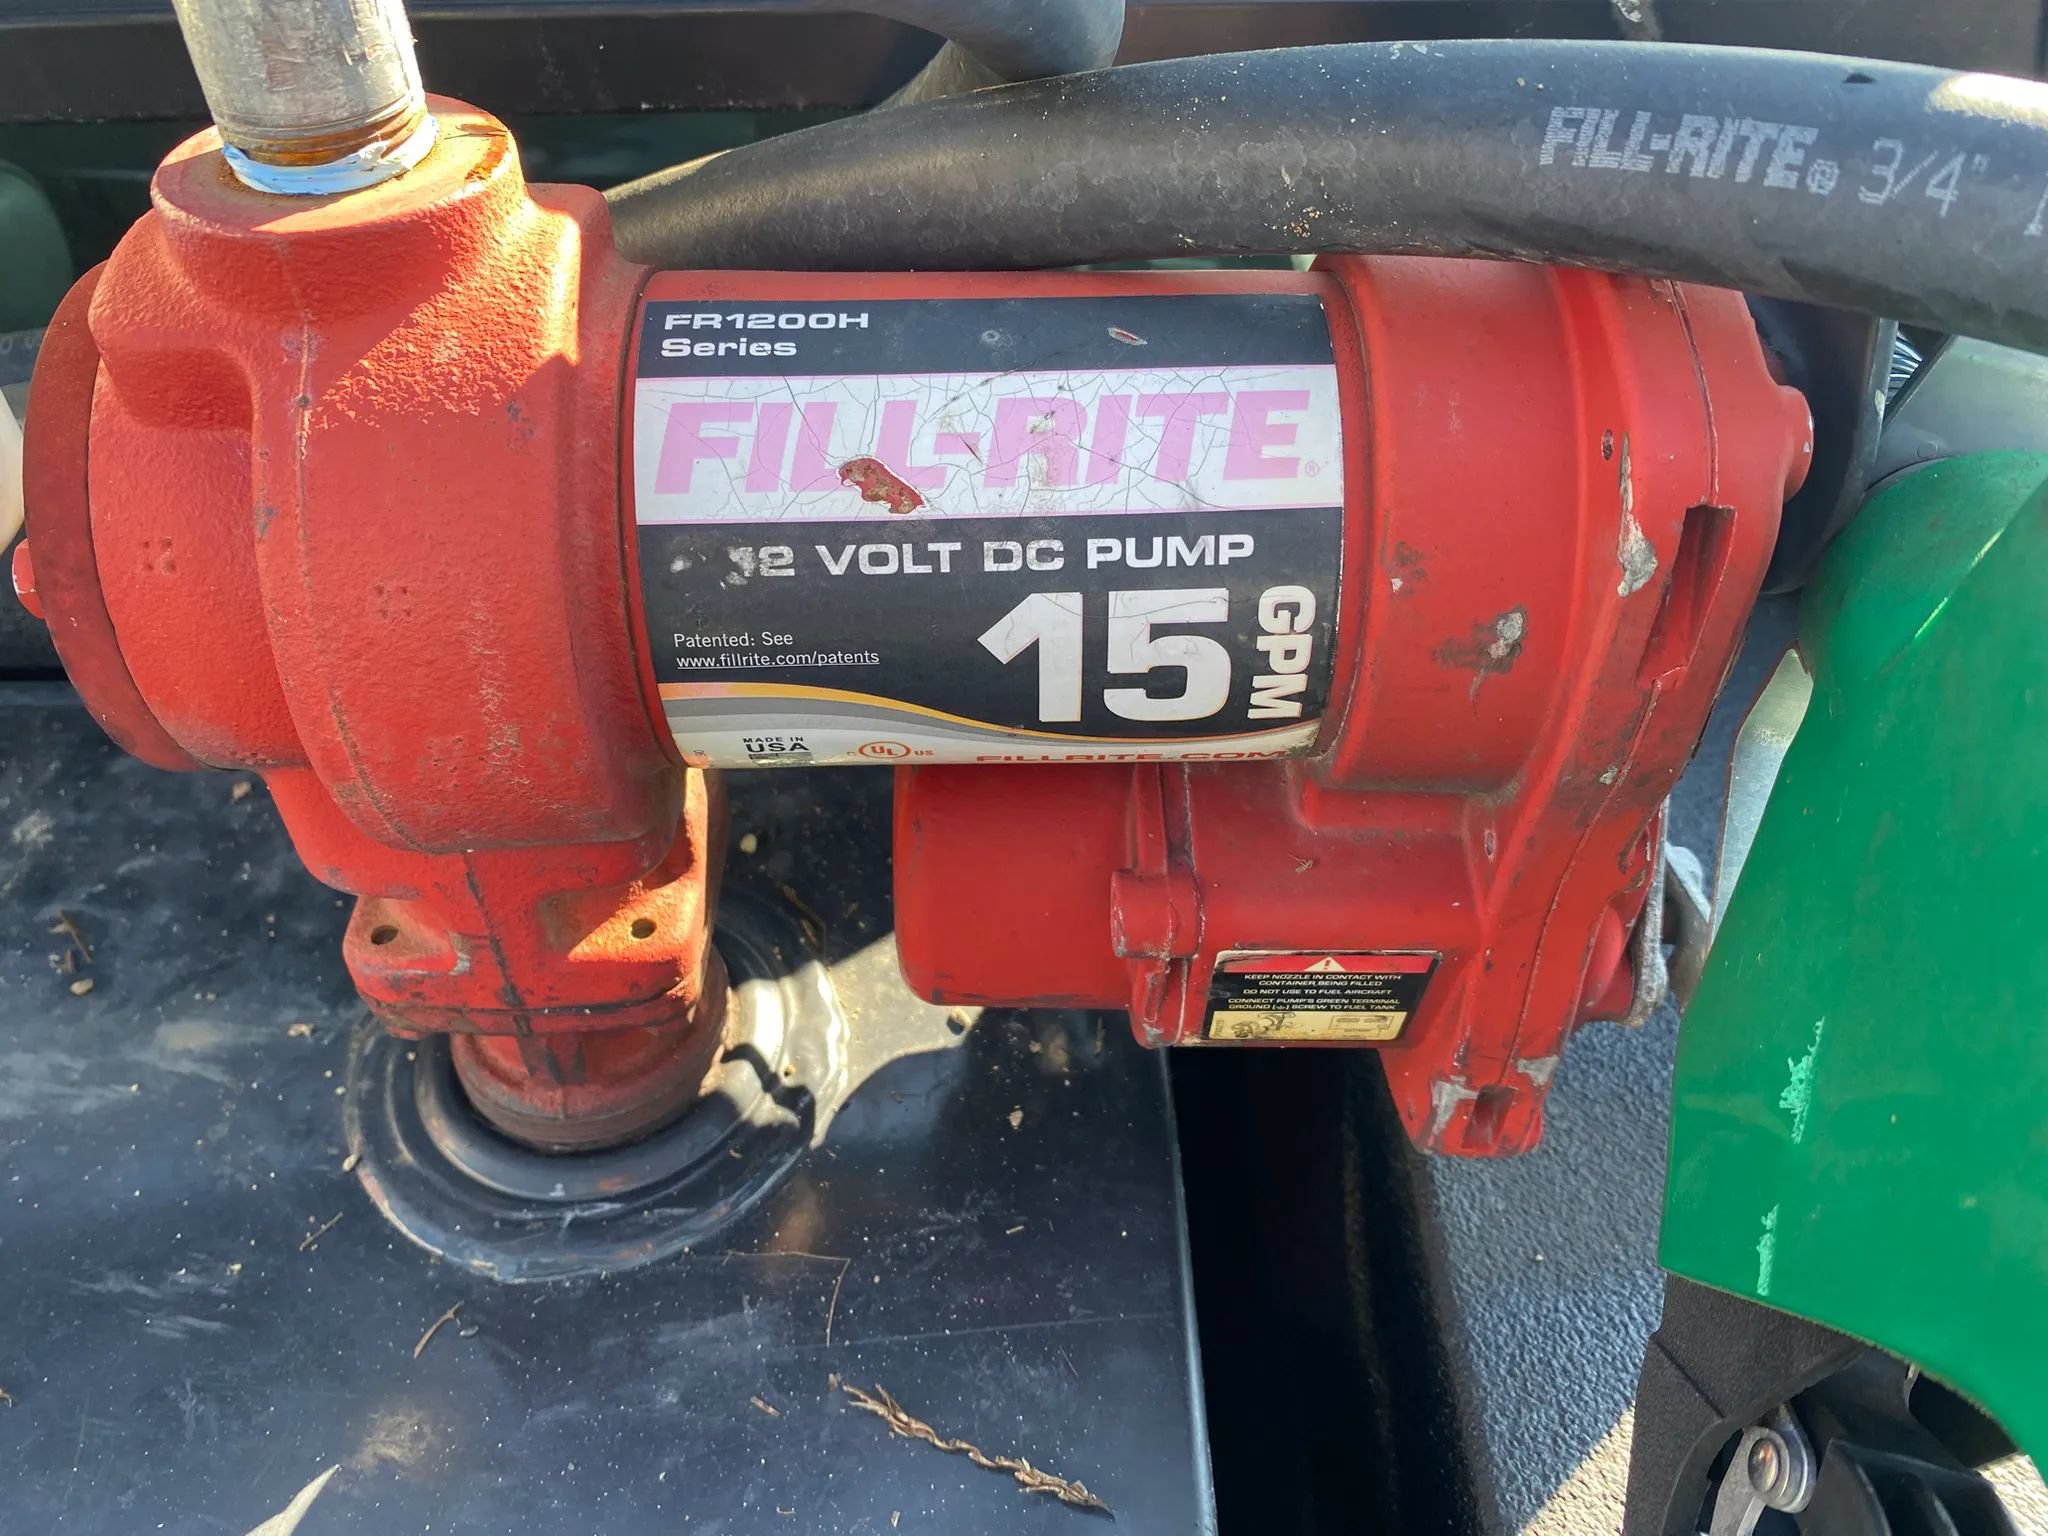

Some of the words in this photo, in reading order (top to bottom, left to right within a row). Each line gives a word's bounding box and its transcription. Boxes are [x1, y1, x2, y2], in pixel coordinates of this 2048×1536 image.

[1857, 138, 1990, 219] 3/4"
[663, 312, 870, 331] FR1200H
[660, 338, 798, 358] Series
[815, 541, 962, 576] VOLT
[983, 538, 1065, 573] DC
[1086, 533, 1255, 570] PUMP
[673, 632, 756, 648] Patented:
[761, 631, 794, 646] See
[676, 650, 881, 669] www.fillrite.com/patents
[976, 587, 1232, 723] 15
[1247, 584, 1317, 720] GPM
[745, 742, 811, 753] USA
[976, 750, 1288, 762] FILLRITE.COM
